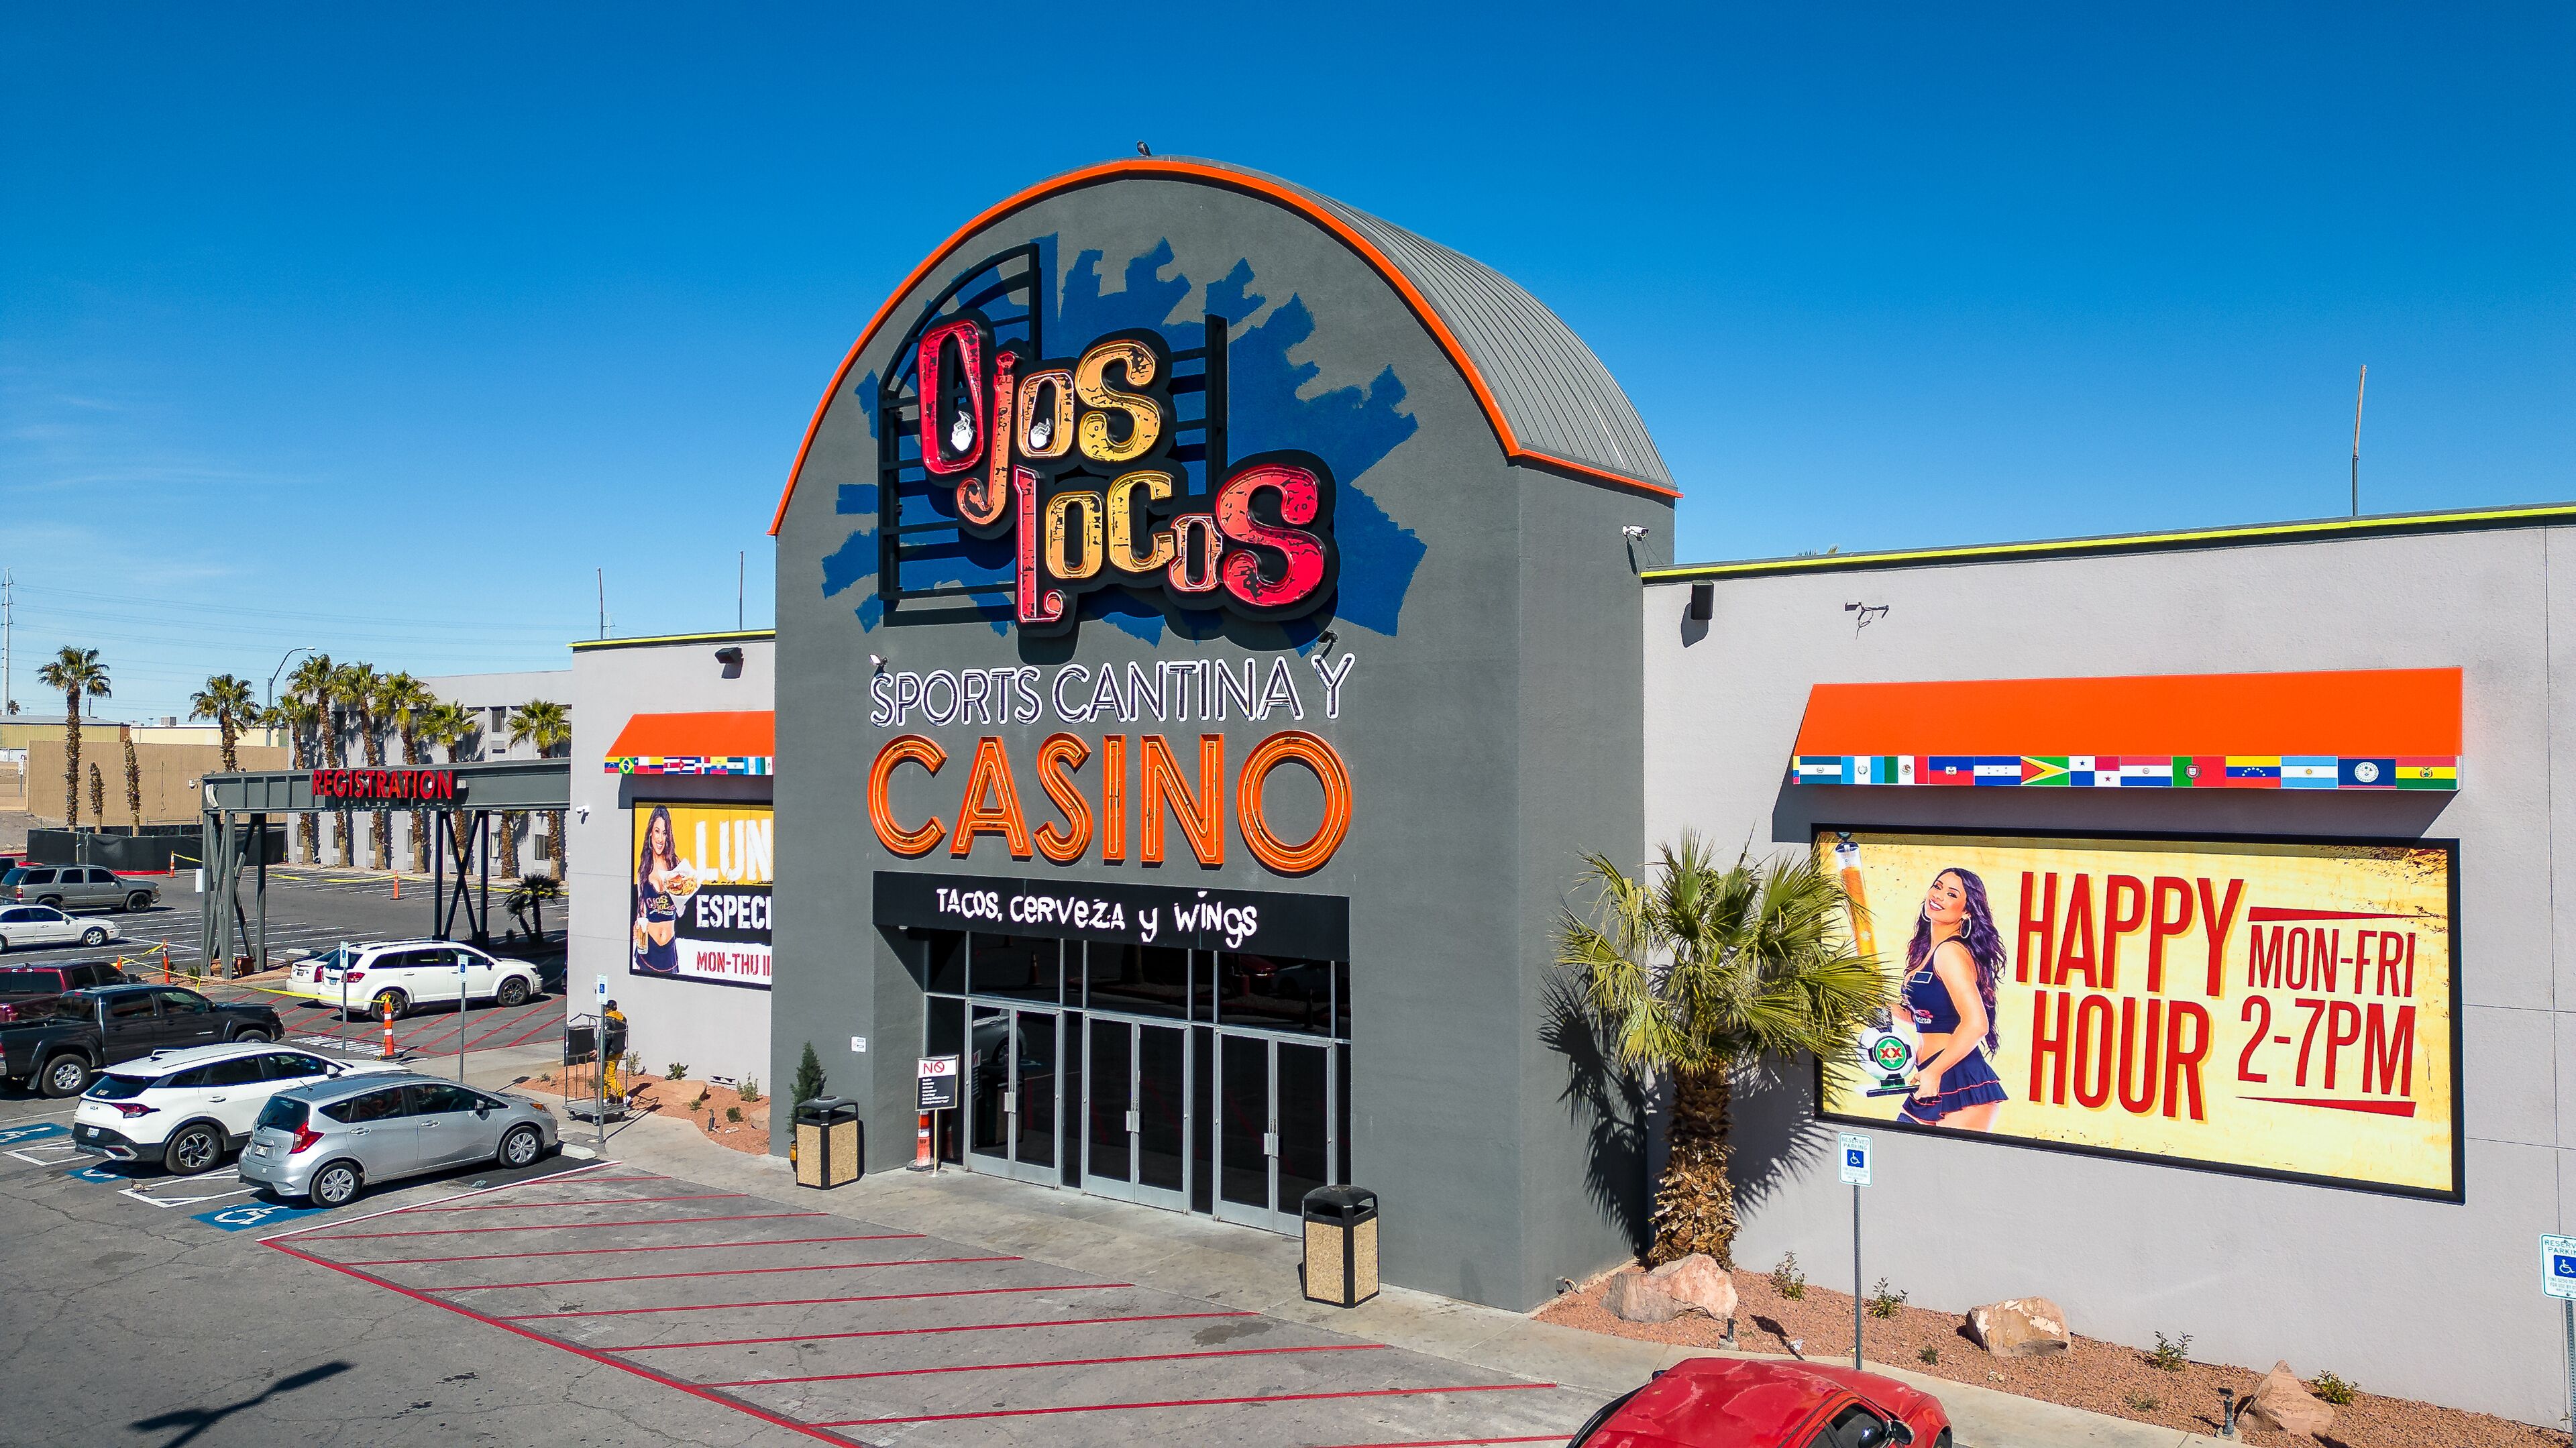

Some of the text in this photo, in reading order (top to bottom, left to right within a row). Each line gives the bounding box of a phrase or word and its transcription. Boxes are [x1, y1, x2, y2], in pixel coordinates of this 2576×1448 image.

[869, 653, 1356, 727] SPORTS CANTINA Y
[312, 769, 453, 799] REGISTRATION
[867, 729, 1352, 874] CASINO
[936, 888, 1003, 922] TACOS,
[2016, 871, 2244, 997] HAPPY
[696, 951, 771, 977] MON-THU 11
[2248, 924, 2416, 998] MON-FRI
[1879, 1047, 1903, 1059] XX
[2029, 990, 2209, 1121] HOUR
[2237, 995, 2416, 1097] 2-7PM
[923, 1060, 945, 1074] NO
[1841, 1137, 1870, 1146] RESERVED
[1843, 1143, 1867, 1151] PARKING
